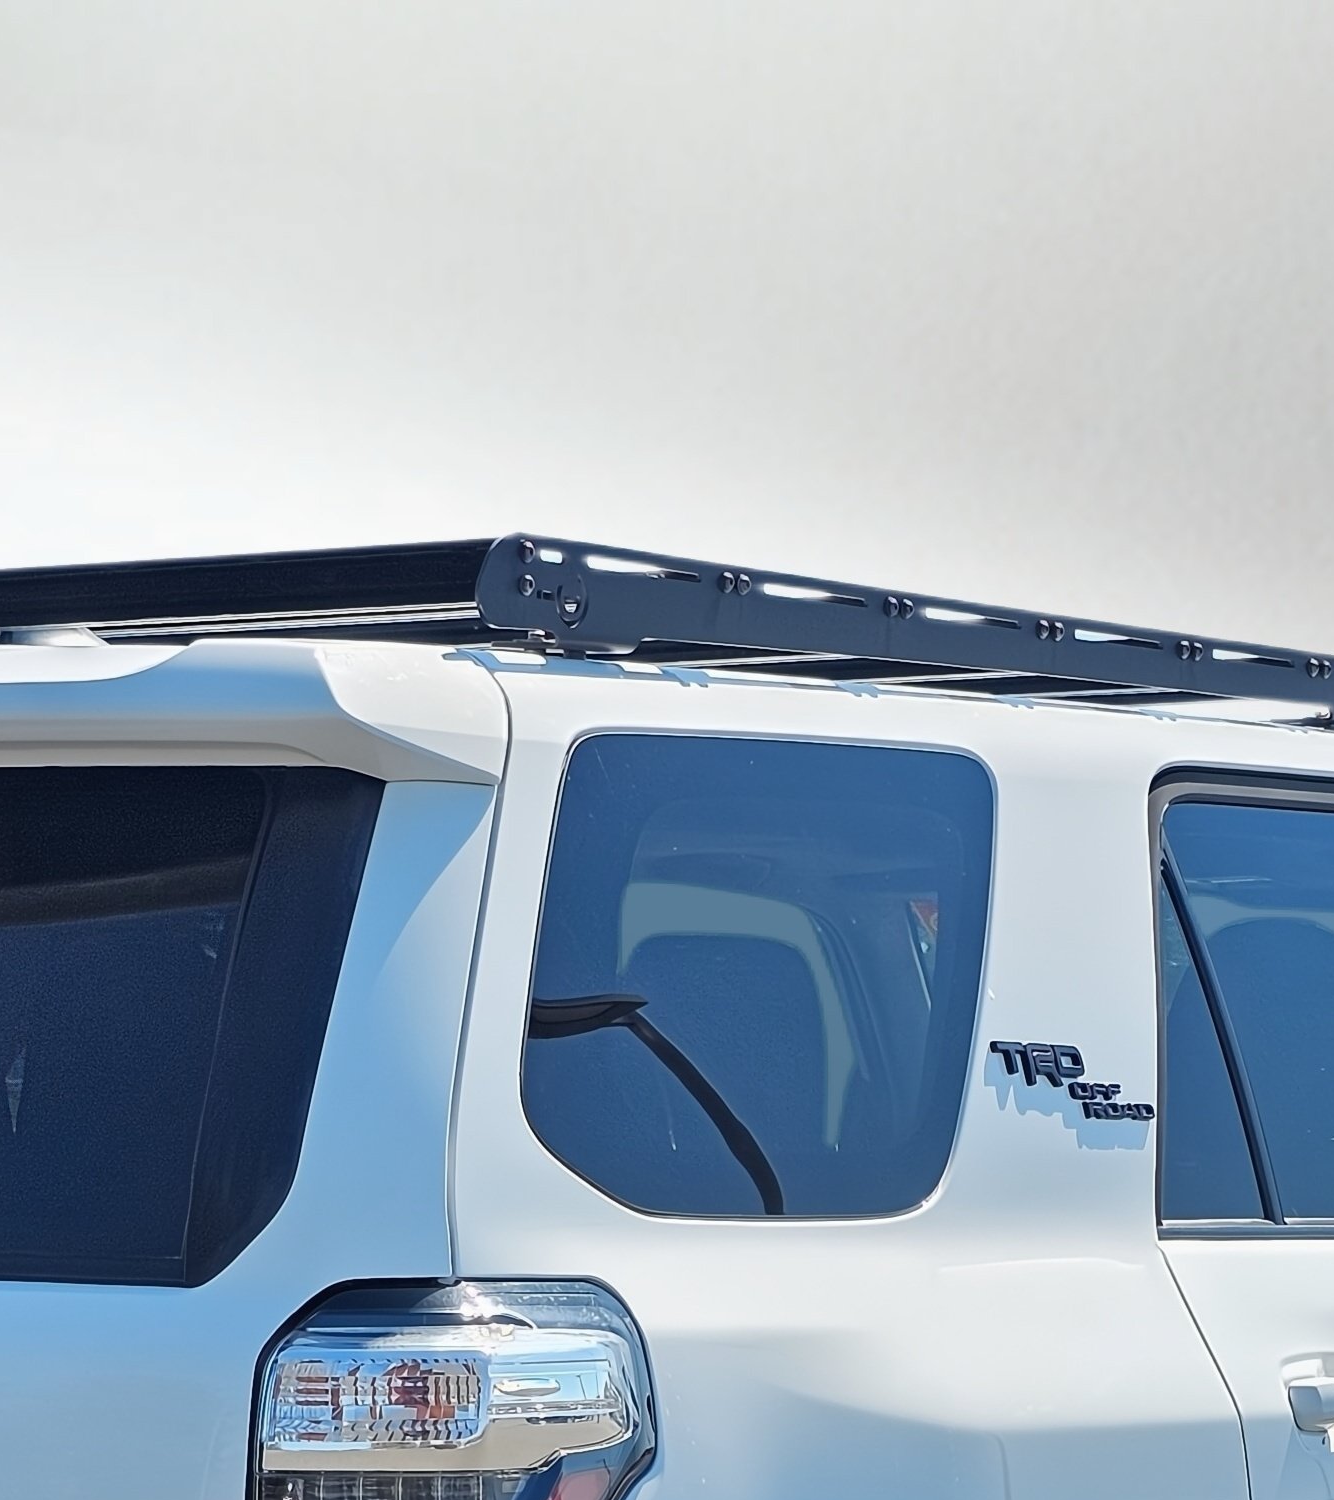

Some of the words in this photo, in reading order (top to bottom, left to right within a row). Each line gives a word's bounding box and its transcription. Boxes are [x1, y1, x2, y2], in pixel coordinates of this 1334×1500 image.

[989, 1041, 1085, 1088] TRD
[1067, 1081, 1122, 1101] OFF
[1081, 1101, 1156, 1121] ROAD
